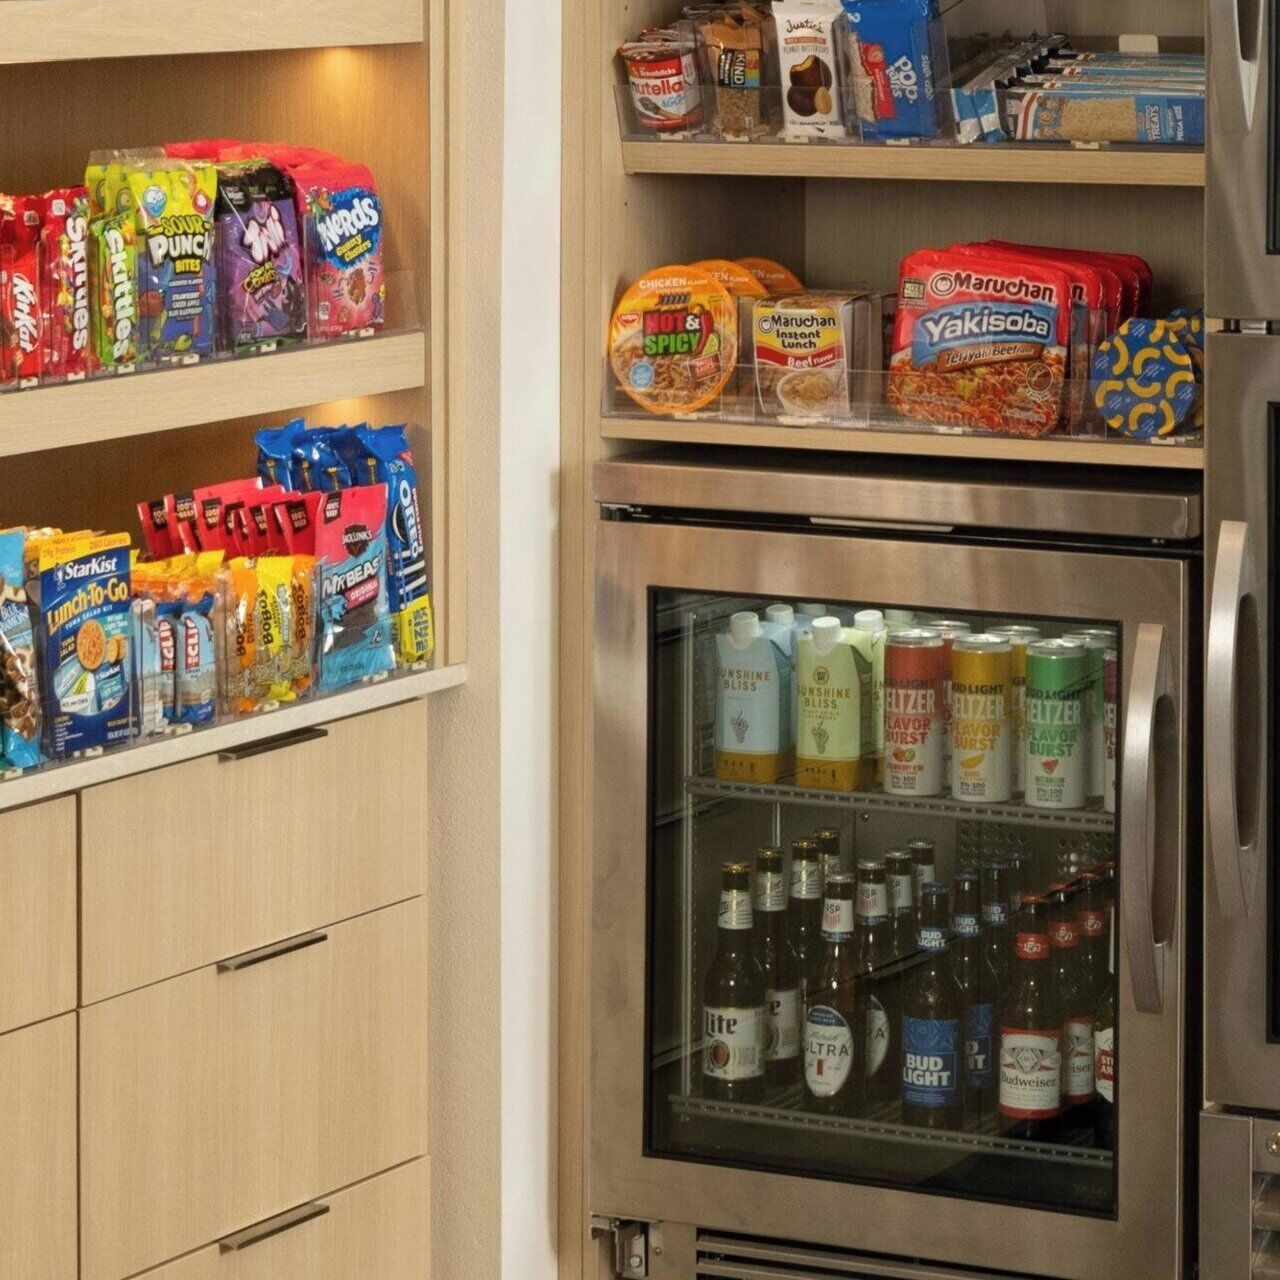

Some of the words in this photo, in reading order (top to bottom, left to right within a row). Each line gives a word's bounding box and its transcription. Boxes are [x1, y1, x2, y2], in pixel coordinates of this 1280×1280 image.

[734, 54, 745, 84] KIND
[162, 217, 204, 235] SOUR
[318, 198, 380, 252] Nerds
[149, 229, 214, 267] PUNCH
[175, 258, 201, 273] BITES
[639, 277, 688, 290] CHICKEN
[953, 270, 1055, 302] Maruchan
[644, 311, 685, 333] HOT
[685, 315, 701, 331] &
[771, 314, 837, 328] Maruchan
[925, 311, 1050, 343] Yakisoba
[644, 333, 700, 352] SPICY
[776, 329, 821, 340] Instant
[781, 339, 817, 349] Lunch
[787, 356, 813, 367] Beef
[945, 349, 990, 367] Teriyaki
[992, 345, 1017, 357] Beef
[399, 480, 420, 558] OREO
[64, 555, 117, 580] StarKist
[103, 604, 113, 613] KIT
[724, 679, 757, 692] BLISS
[968, 684, 1004, 695] LIGHT
[804, 698, 838, 708] BLISS
[885, 730, 929, 745] BURST
[1028, 727, 1078, 743] FLAVOR
[954, 737, 998, 751] BURST
[1029, 742, 1075, 758] BURST
[921, 930, 942, 939] BUD
[705, 1013, 738, 1037] Lite
[906, 1053, 944, 1071] BUD
[903, 1071, 951, 1087] LIGHT
[1000, 1069, 1057, 1089] Budweiser
